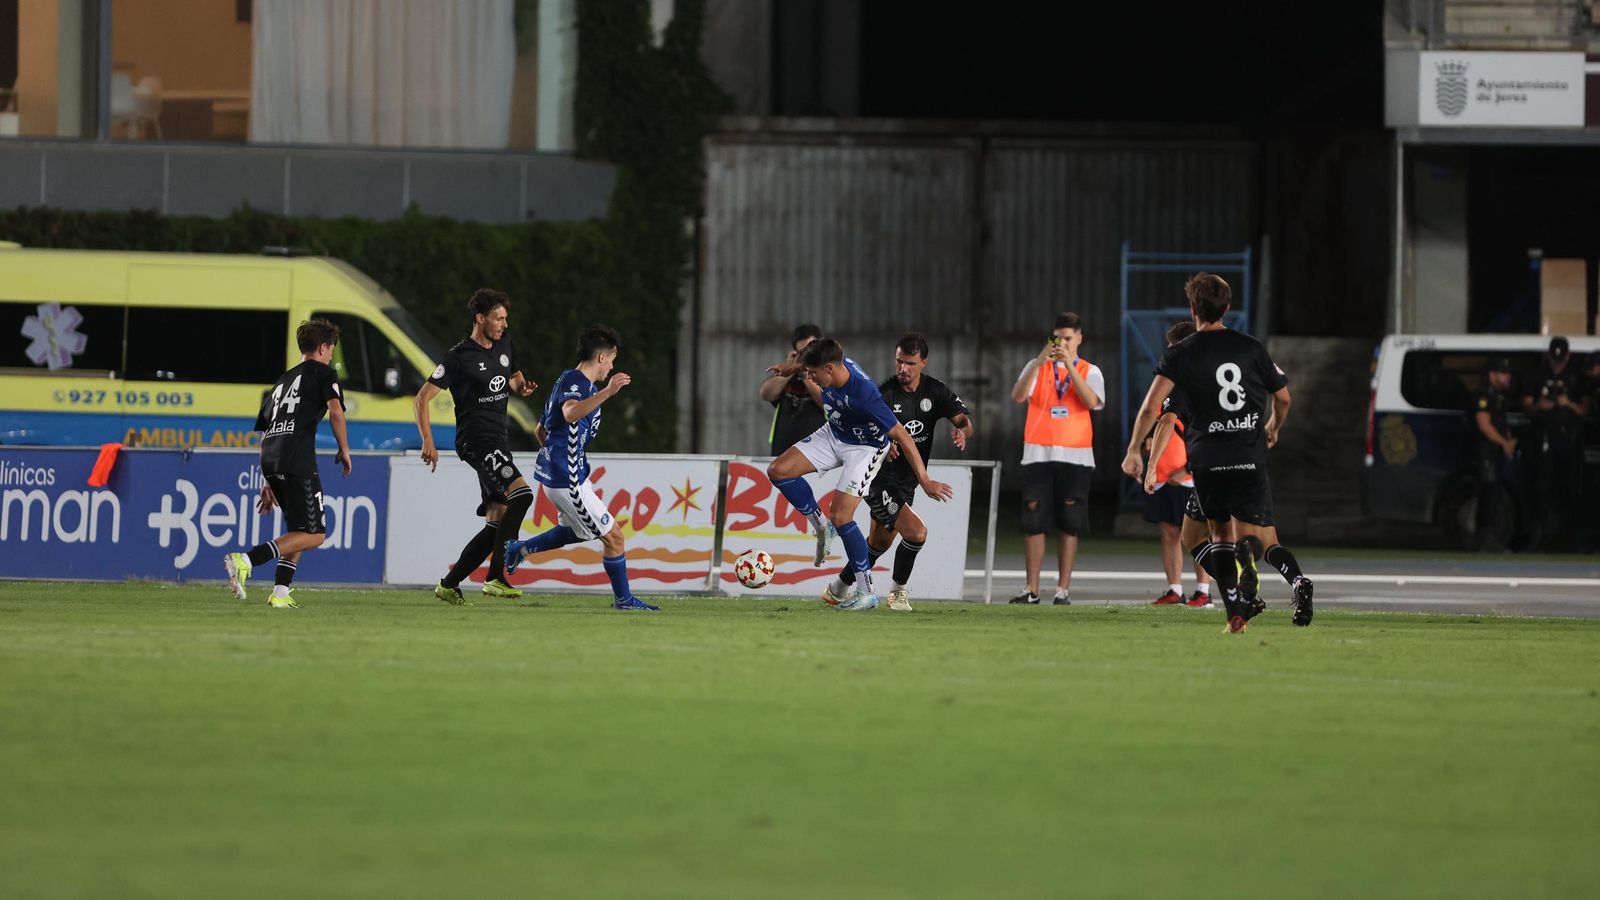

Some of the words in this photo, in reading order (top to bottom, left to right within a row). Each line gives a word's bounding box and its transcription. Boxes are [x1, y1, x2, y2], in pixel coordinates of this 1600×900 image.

[1476, 78, 1569, 92] Ayuntamiento
[1476, 92, 1491, 102] de
[1215, 362, 1247, 411] 8
[69, 389, 106, 402] 927
[116, 390, 150, 404] 105
[156, 391, 194, 405] 003
[271, 374, 302, 422] 14
[123, 427, 263, 449] AMBULANC
[484, 449, 509, 471] 21
[882, 490, 894, 506] 4
